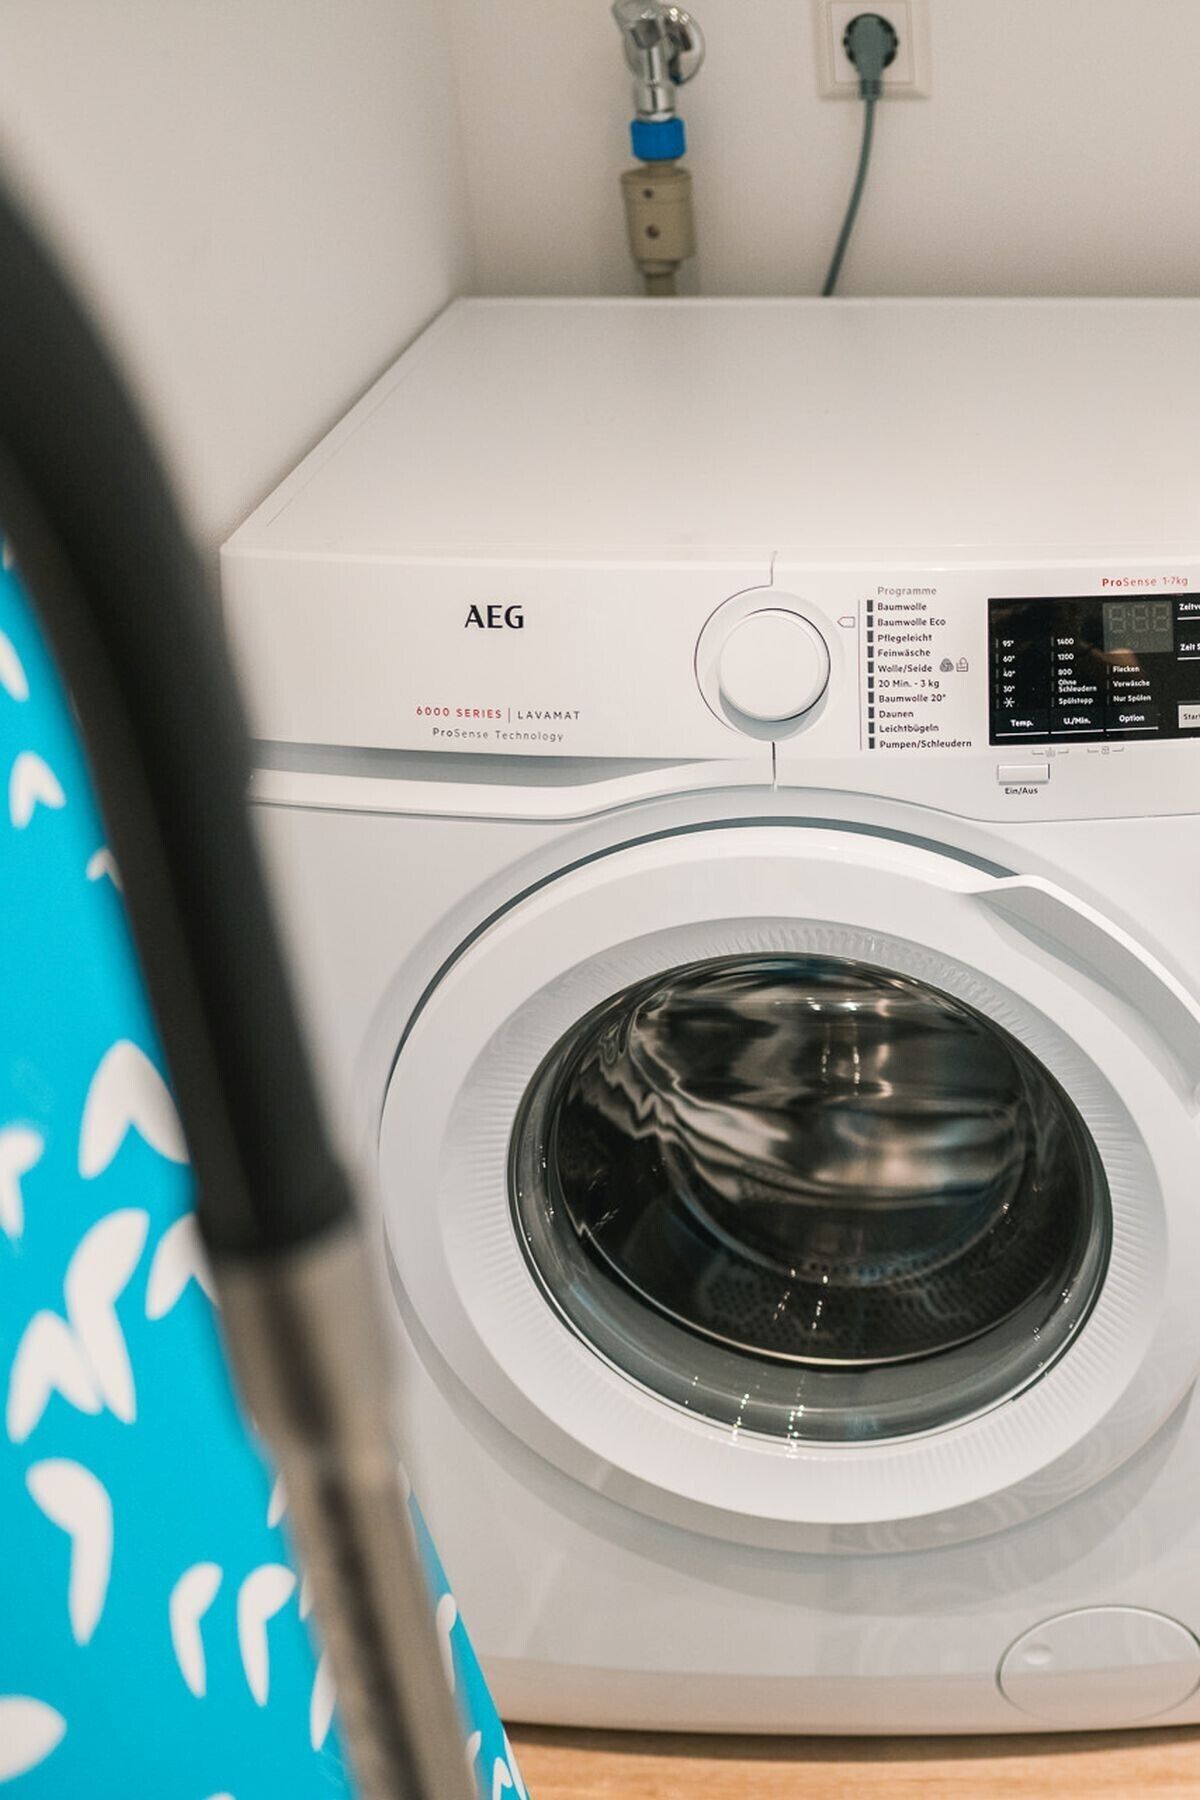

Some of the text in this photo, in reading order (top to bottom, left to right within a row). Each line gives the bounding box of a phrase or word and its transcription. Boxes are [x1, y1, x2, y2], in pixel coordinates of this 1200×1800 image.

[1102, 577, 1157, 587] ProSense
[877, 586, 937, 597] Programme
[877, 602, 927, 611] Baumwolle
[464, 604, 524, 629] AEG
[877, 617, 946, 627] Baumwolle Eco
[877, 633, 932, 644] Pflegeleicht
[1180, 643, 1195, 651] Zeit
[877, 648, 931, 657] Feinwäsche
[878, 663, 933, 673] Wolle/Seide
[1113, 665, 1140, 673] Flecken
[878, 680, 890, 688] 20
[892, 679, 912, 688] Min.
[920, 679, 926, 688] 3
[928, 679, 940, 691] kg
[1113, 679, 1150, 687] Vorwäsche
[1058, 685, 1097, 693] Schleudern
[878, 693, 947, 703] Baumwolle 20°
[1058, 697, 1094, 705] Spülstopp
[1127, 694, 1151, 703] Spülen
[416, 705, 581, 721] 6000 SERIES LAVAMAT
[879, 710, 914, 718] Daunen
[1010, 719, 1034, 727] Temp.
[1119, 714, 1145, 723] Option
[879, 723, 939, 734] Leichtbügeln
[432, 727, 564, 743] ProSense Technology
[879, 739, 972, 750] Pumpen/Schleudern
[1005, 787, 1038, 796] Ein/Aus
